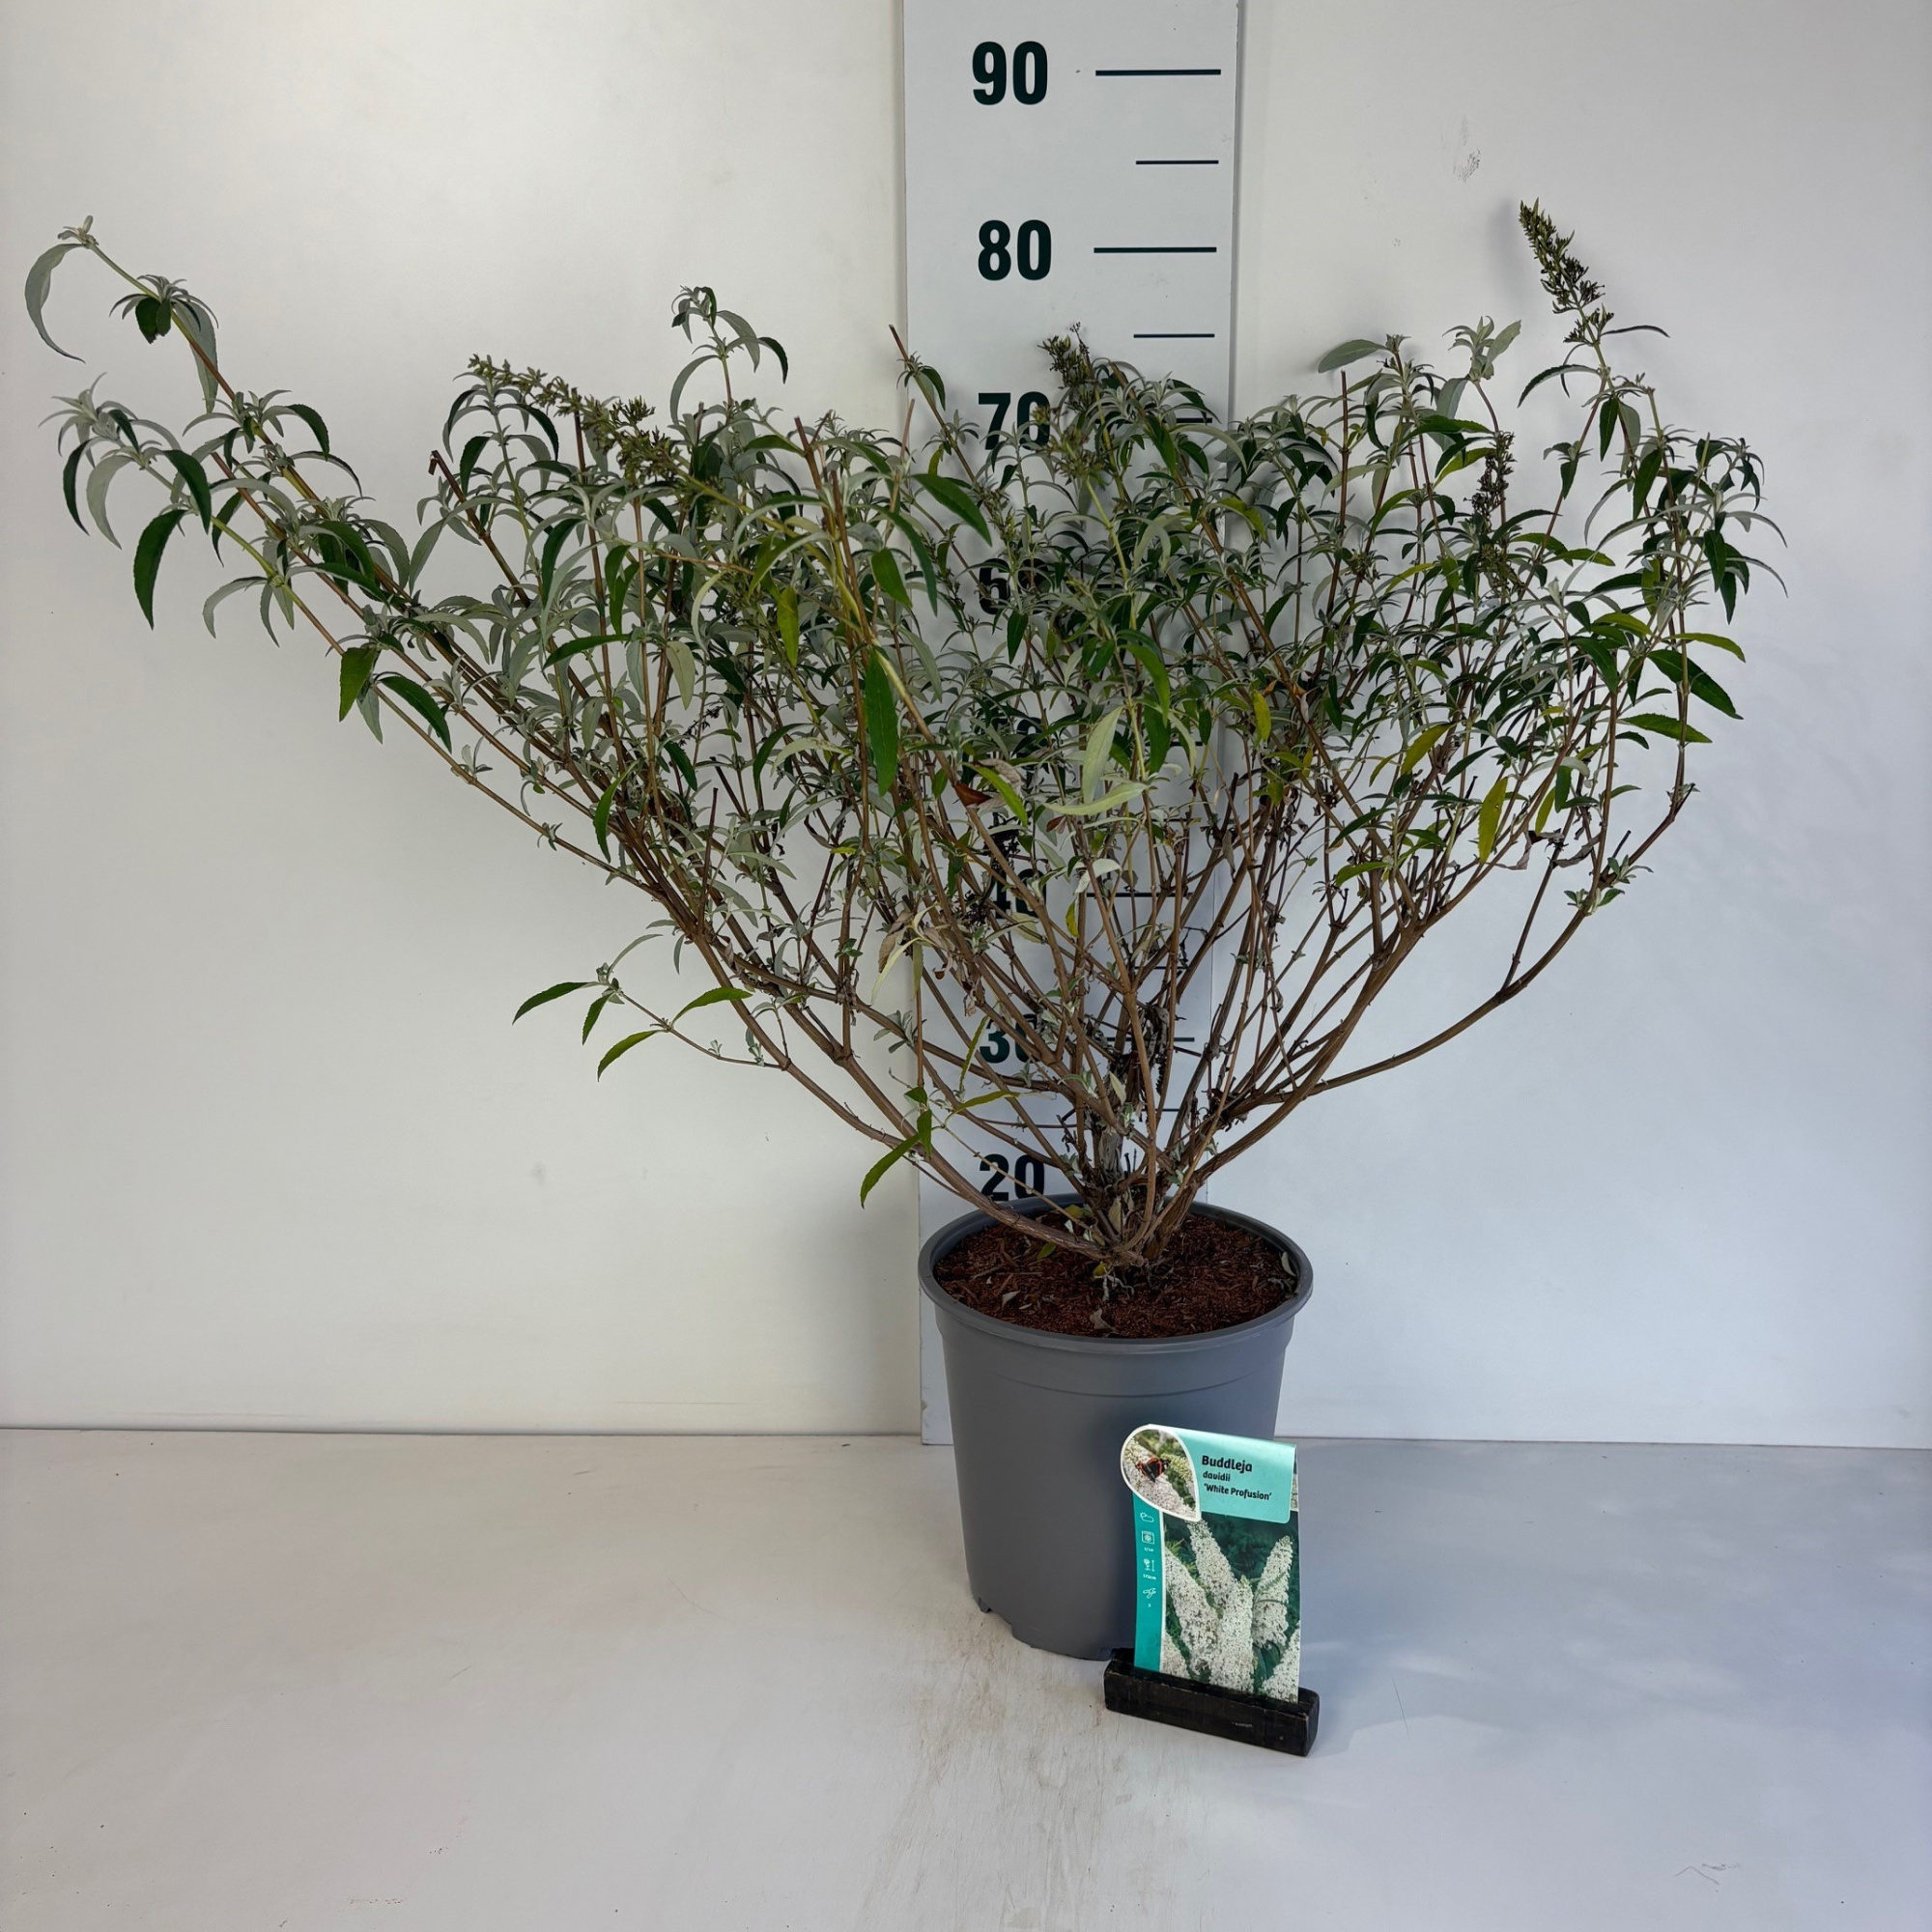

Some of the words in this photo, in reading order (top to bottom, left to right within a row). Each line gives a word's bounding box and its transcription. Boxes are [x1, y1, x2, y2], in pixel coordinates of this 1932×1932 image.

[972, 41, 1048, 105] 90
[978, 219, 1051, 281] 80
[978, 391, 1050, 451] 70
[979, 1153, 1044, 1202] 20
[1202, 1455, 1253, 1473] Buddleja
[1203, 1470, 1231, 1482] davidii
